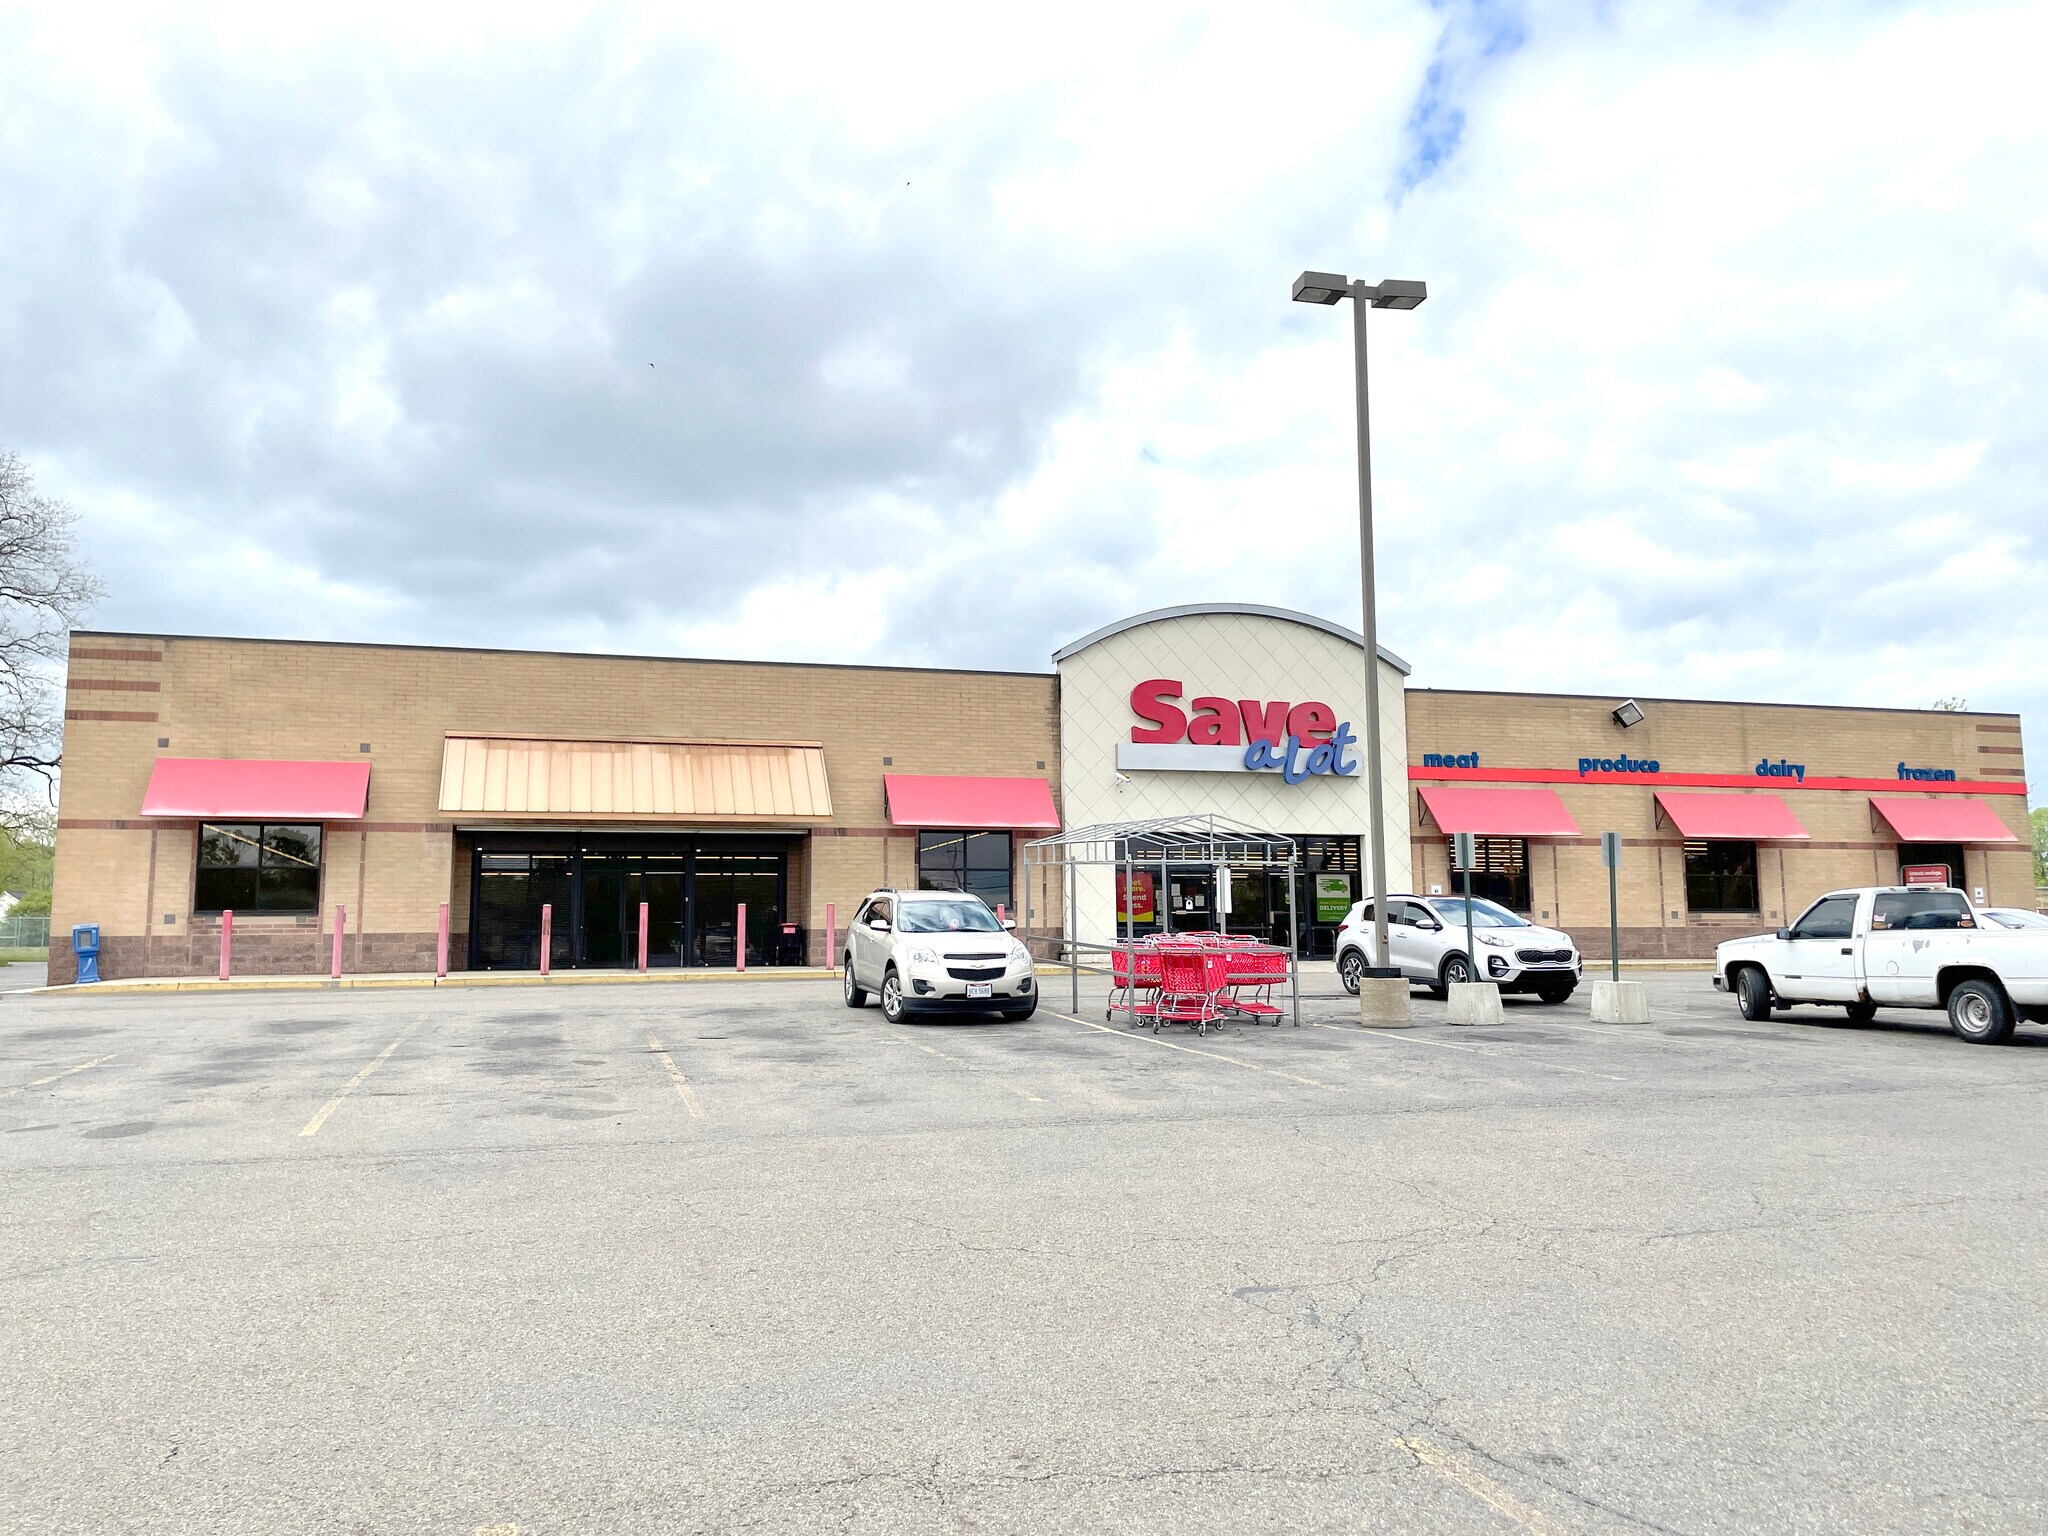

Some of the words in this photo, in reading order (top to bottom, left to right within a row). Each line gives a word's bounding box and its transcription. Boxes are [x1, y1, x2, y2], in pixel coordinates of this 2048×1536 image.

[1130, 679, 1337, 748] Save
[1244, 738, 1286, 770] a
[1423, 752, 1479, 768] meat
[1578, 754, 1660, 777] produce
[1755, 758, 1805, 783] dairy
[1897, 761, 1956, 782] frozen
